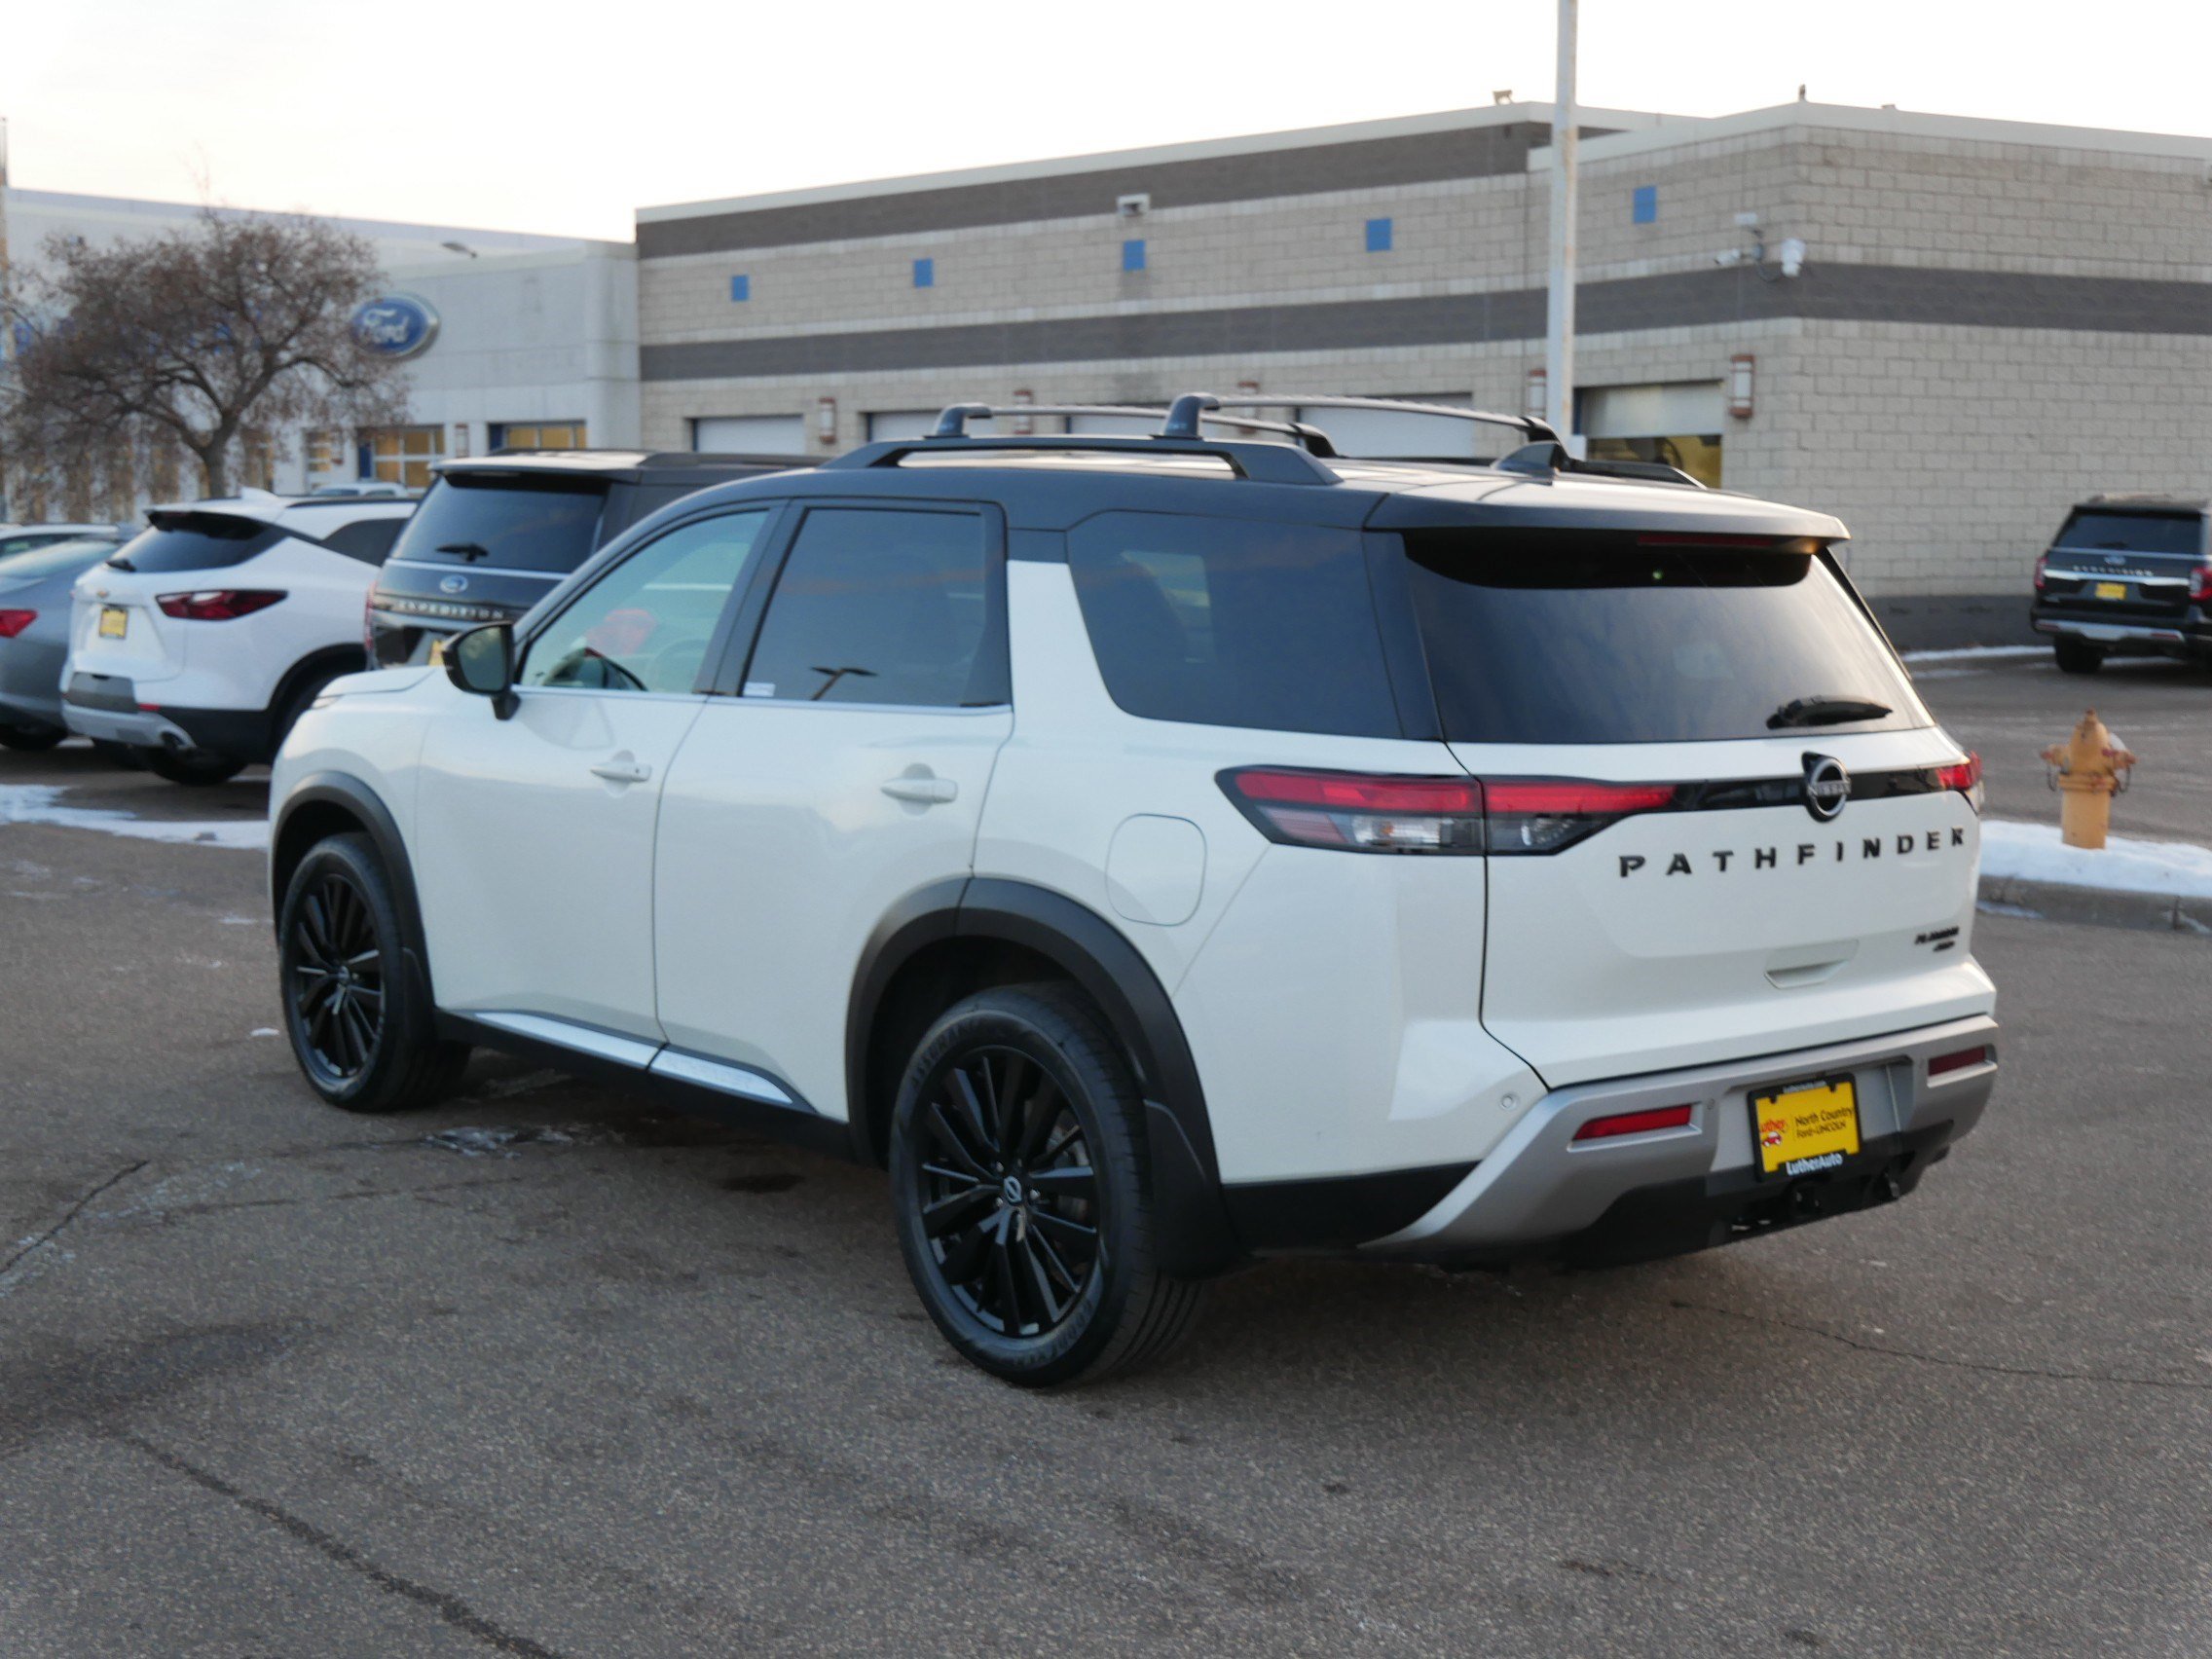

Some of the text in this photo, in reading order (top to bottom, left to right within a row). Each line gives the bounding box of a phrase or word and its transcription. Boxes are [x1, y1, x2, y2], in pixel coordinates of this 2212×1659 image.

[358, 307, 411, 345] Ford
[1619, 827, 1965, 877] PATHFINDER
[1795, 1108, 1853, 1125] North Country
